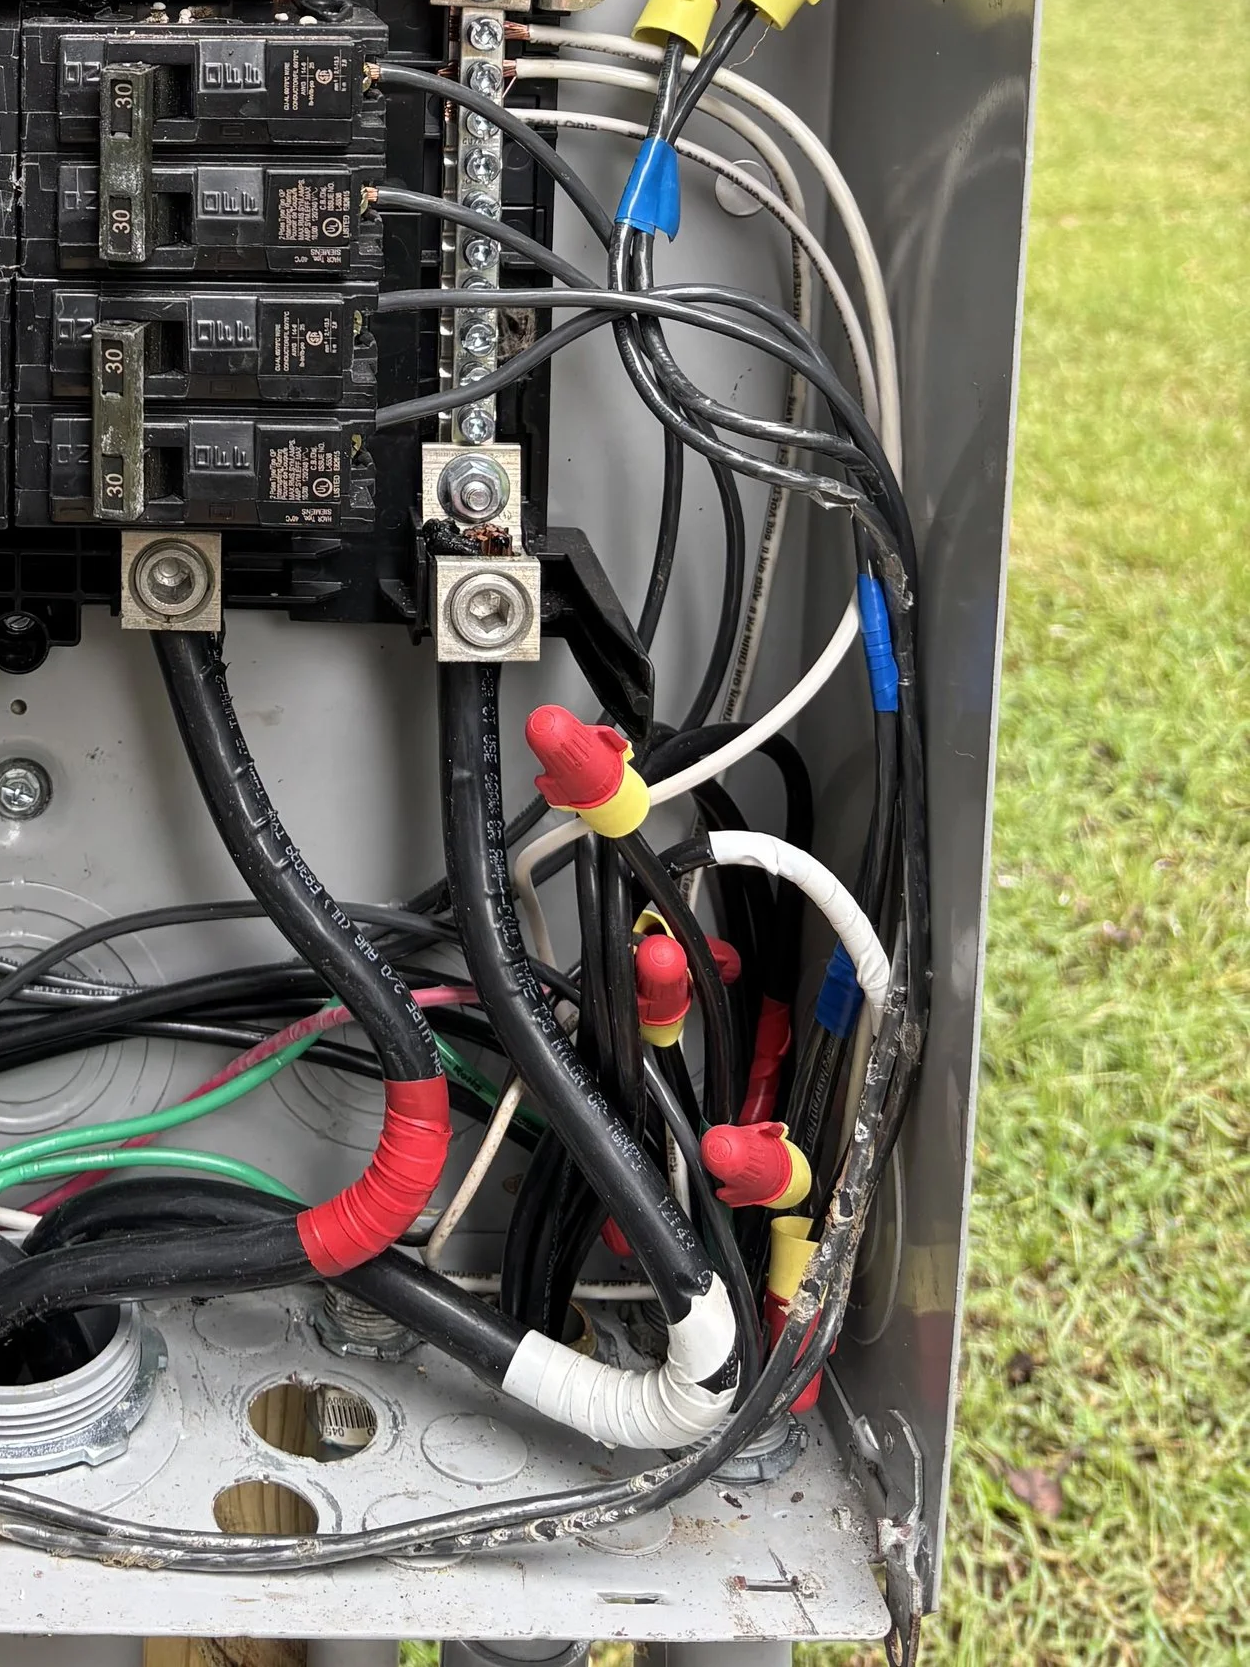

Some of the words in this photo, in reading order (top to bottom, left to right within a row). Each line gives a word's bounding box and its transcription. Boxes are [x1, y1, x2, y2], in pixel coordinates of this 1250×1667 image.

[115, 83, 133, 108] 30
[112, 208, 130, 234] 30
[105, 348, 123, 374] 30
[106, 473, 124, 498] 30
